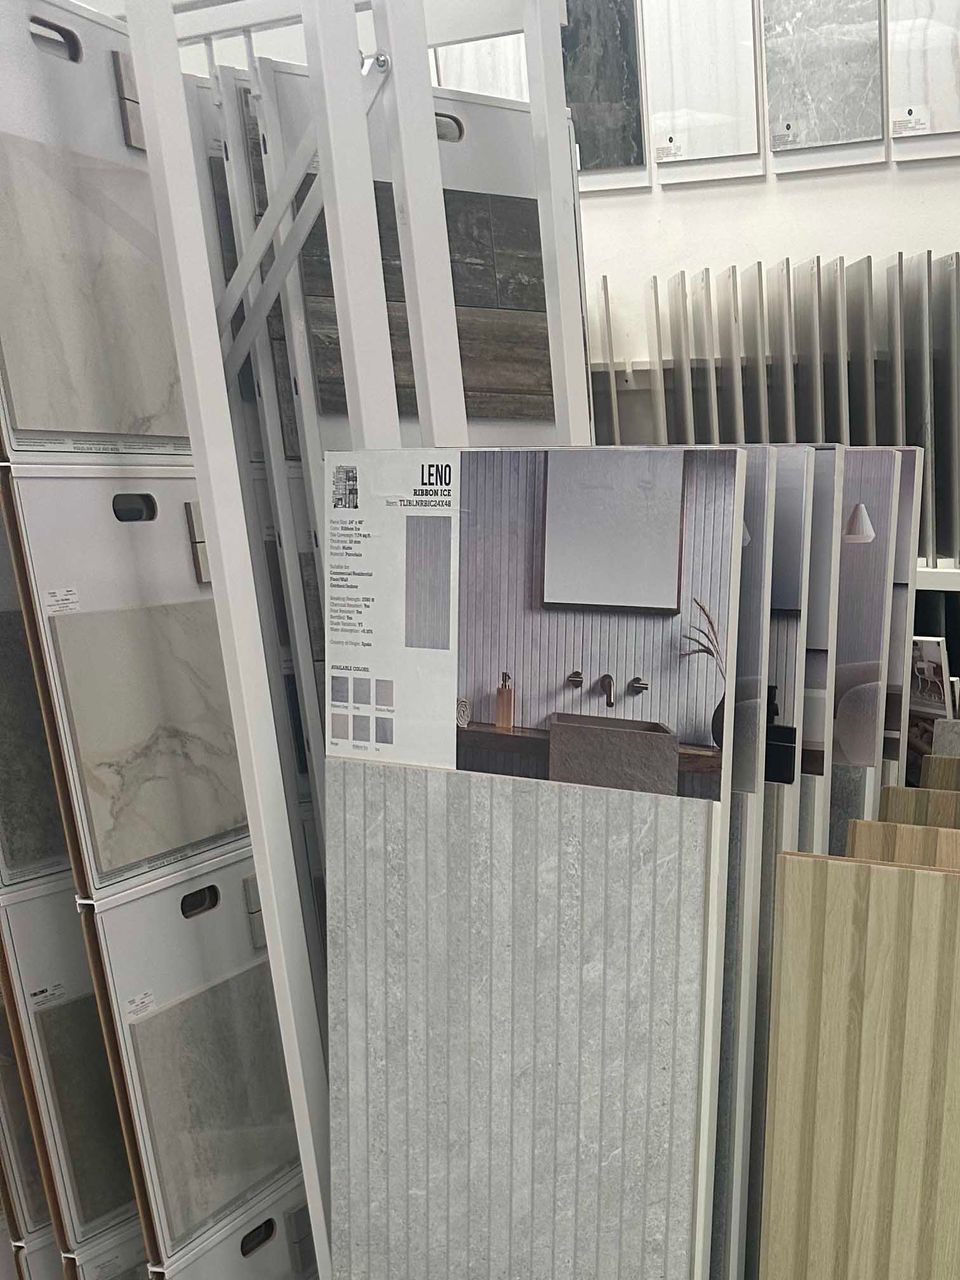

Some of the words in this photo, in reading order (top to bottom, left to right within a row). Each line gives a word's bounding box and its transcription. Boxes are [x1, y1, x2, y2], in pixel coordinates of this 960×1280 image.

[421, 463, 451, 486] LENO
[413, 488, 439, 497] RIBBON
[440, 488, 452, 497] ICE
